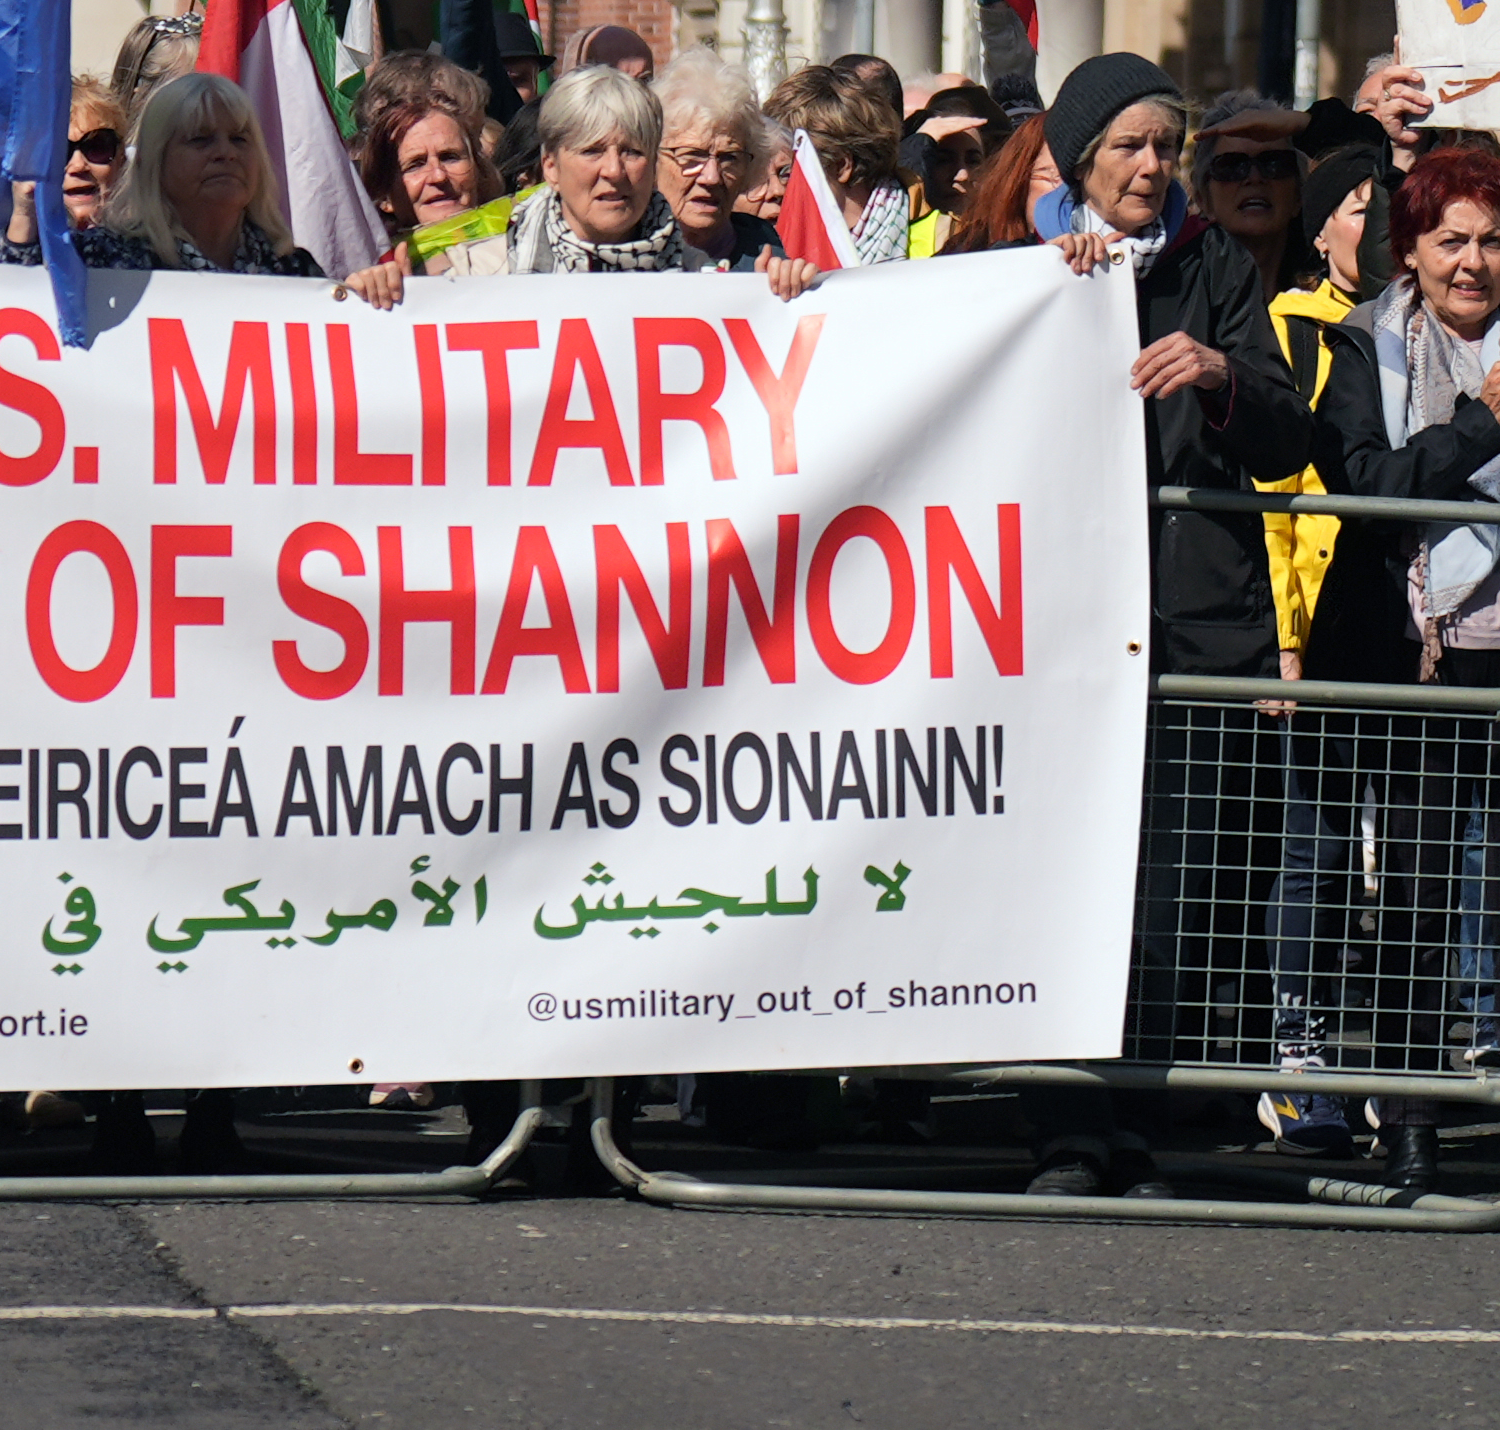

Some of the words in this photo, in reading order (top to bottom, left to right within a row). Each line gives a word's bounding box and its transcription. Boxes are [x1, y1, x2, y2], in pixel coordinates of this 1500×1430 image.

[148, 314, 822, 487] MILITARY
[26, 520, 234, 704] OF
[273, 502, 1025, 701] SHANNON
[274, 742, 534, 837] AMACH
[549, 736, 640, 831] AS
[659, 724, 1005, 827] SIONAINN!
[42, 871, 102, 974] في
[146, 854, 488, 973] الأمريكي
[534, 862, 818, 940] للجيش
[863, 860, 910, 912] لا
[528, 979, 1036, 1023] @usmilitary_out_of_shannon
